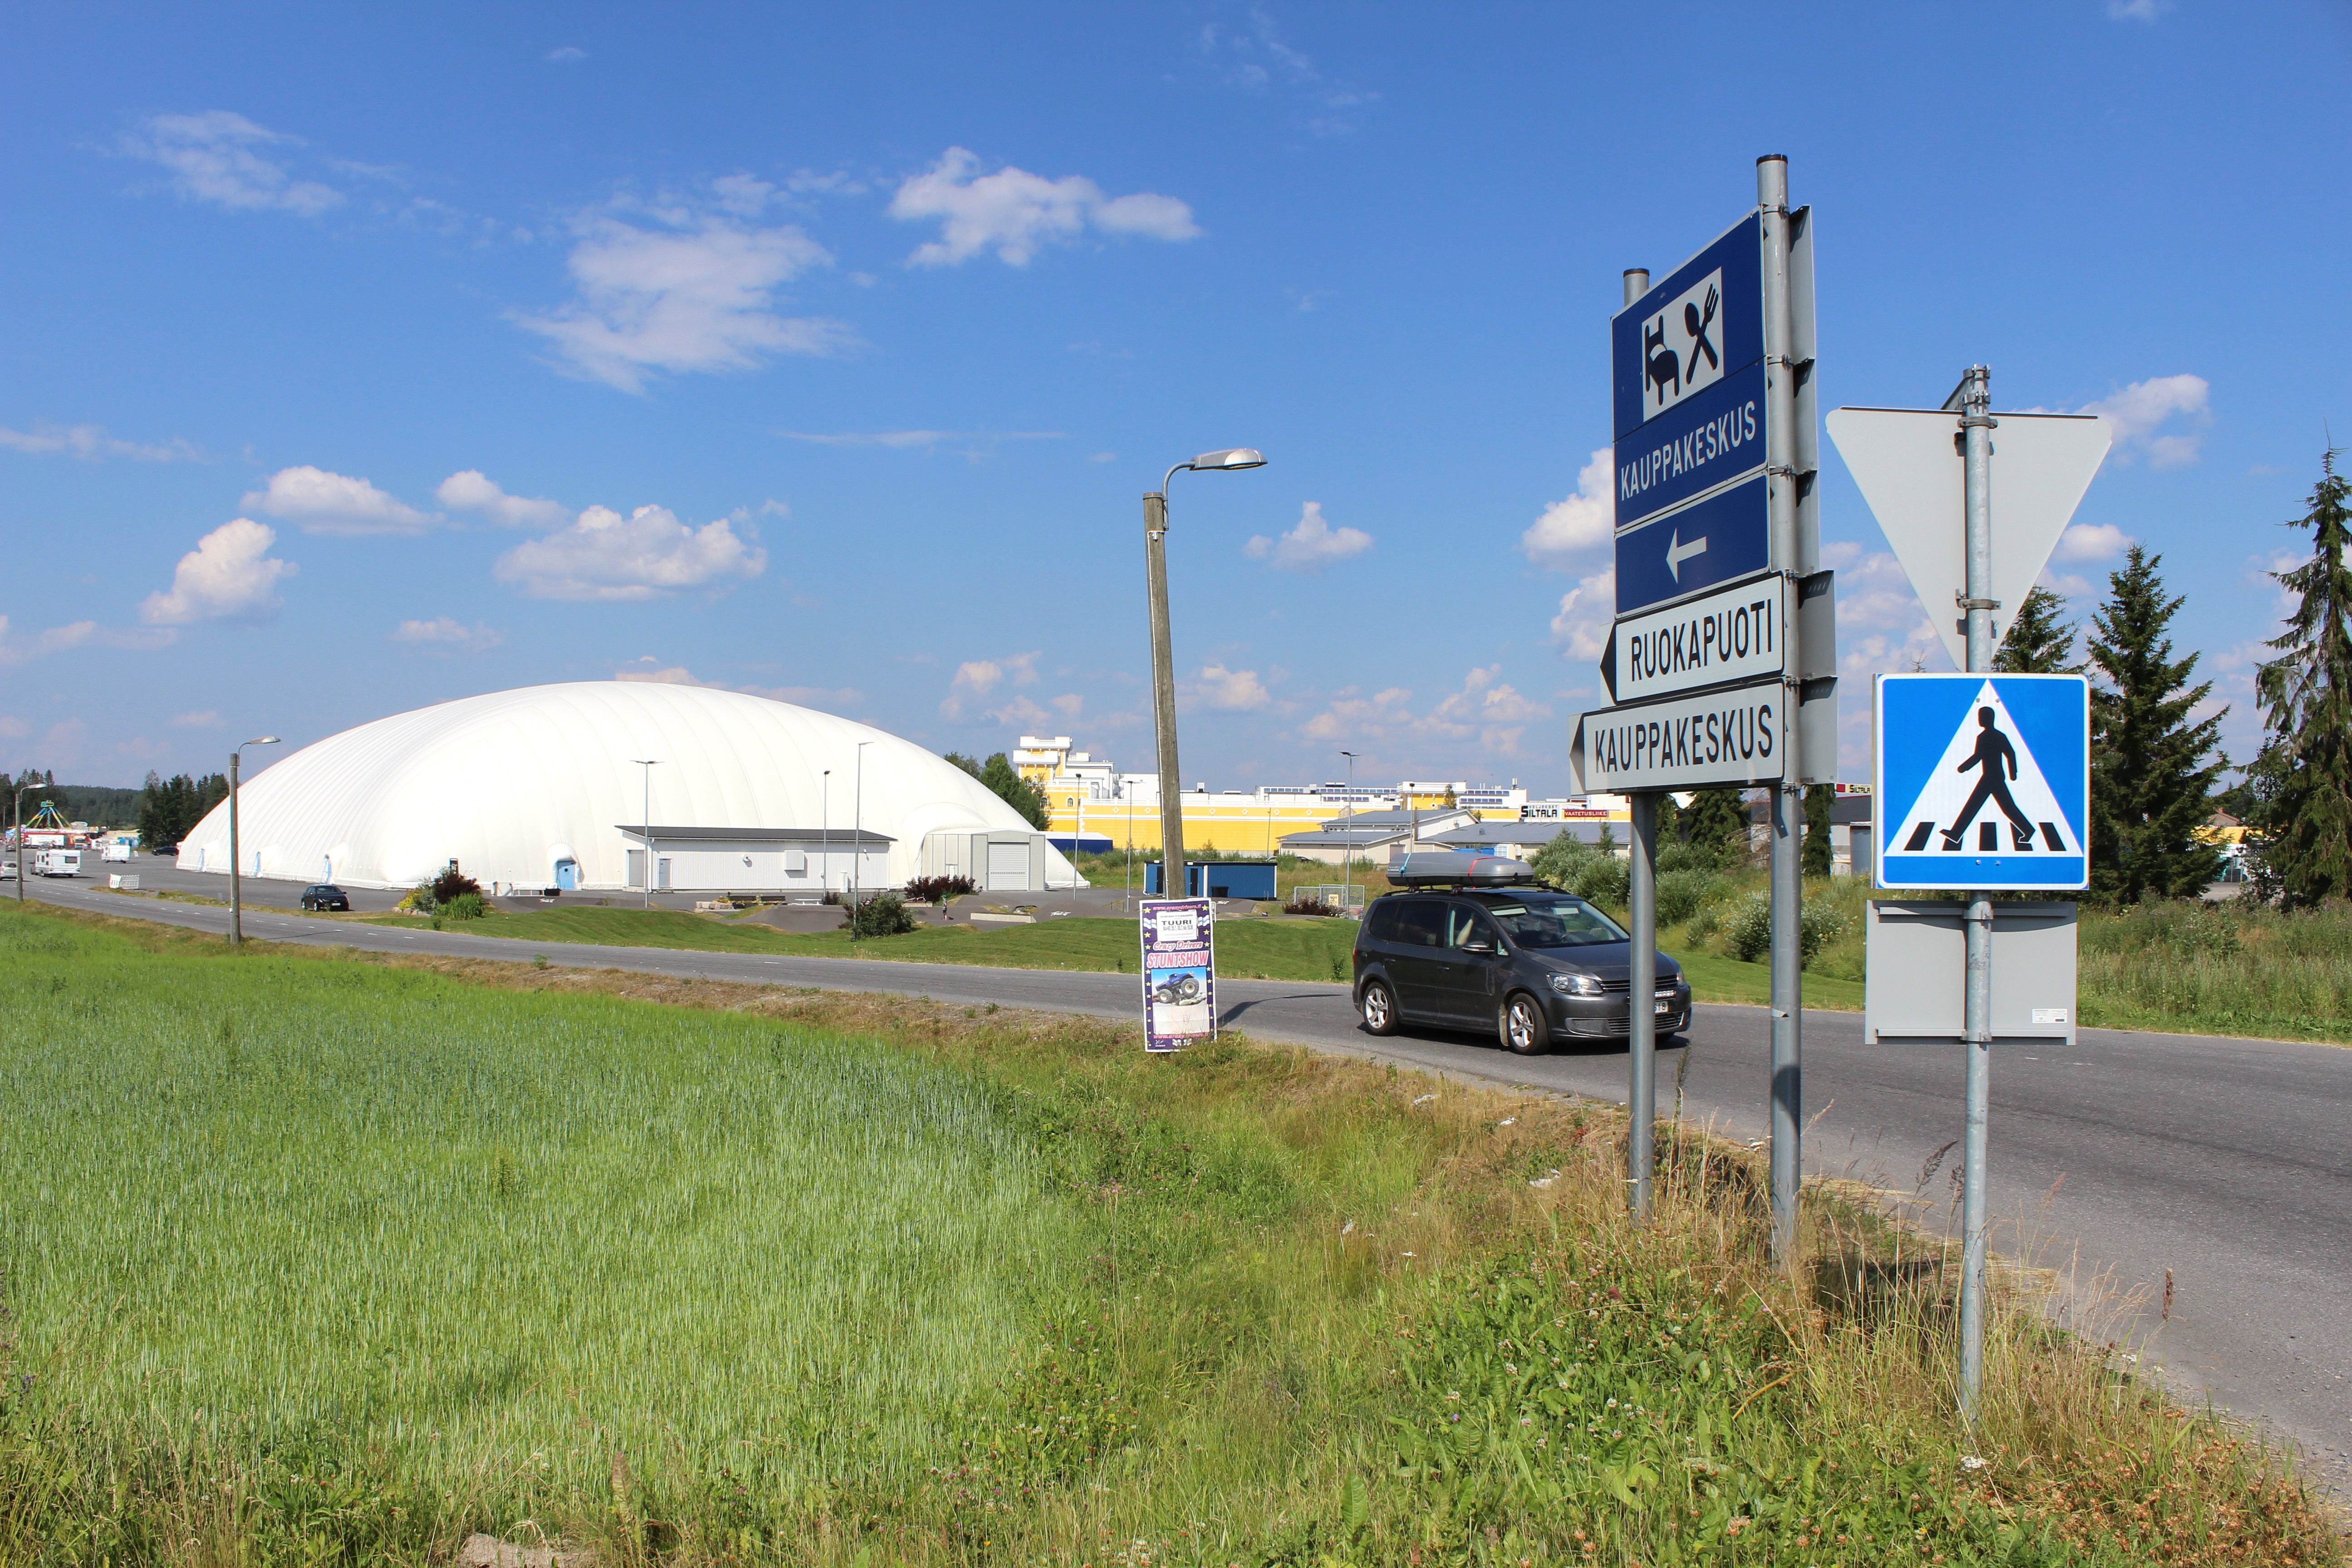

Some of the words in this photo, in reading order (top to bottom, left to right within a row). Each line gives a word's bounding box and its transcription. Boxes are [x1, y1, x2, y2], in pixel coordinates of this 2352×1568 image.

[1621, 401, 1756, 501] KAUPPAKESKUS
[1631, 599, 1772, 682] RUOKAPUOTI
[1595, 704, 1773, 774] KAUPPAKESKUS
[1521, 805, 1558, 818] SILTALA
[1147, 951, 1209, 968] STUNTSHOW
[1153, 941, 1176, 951] Crazy
[1176, 941, 1203, 950] Drivers
